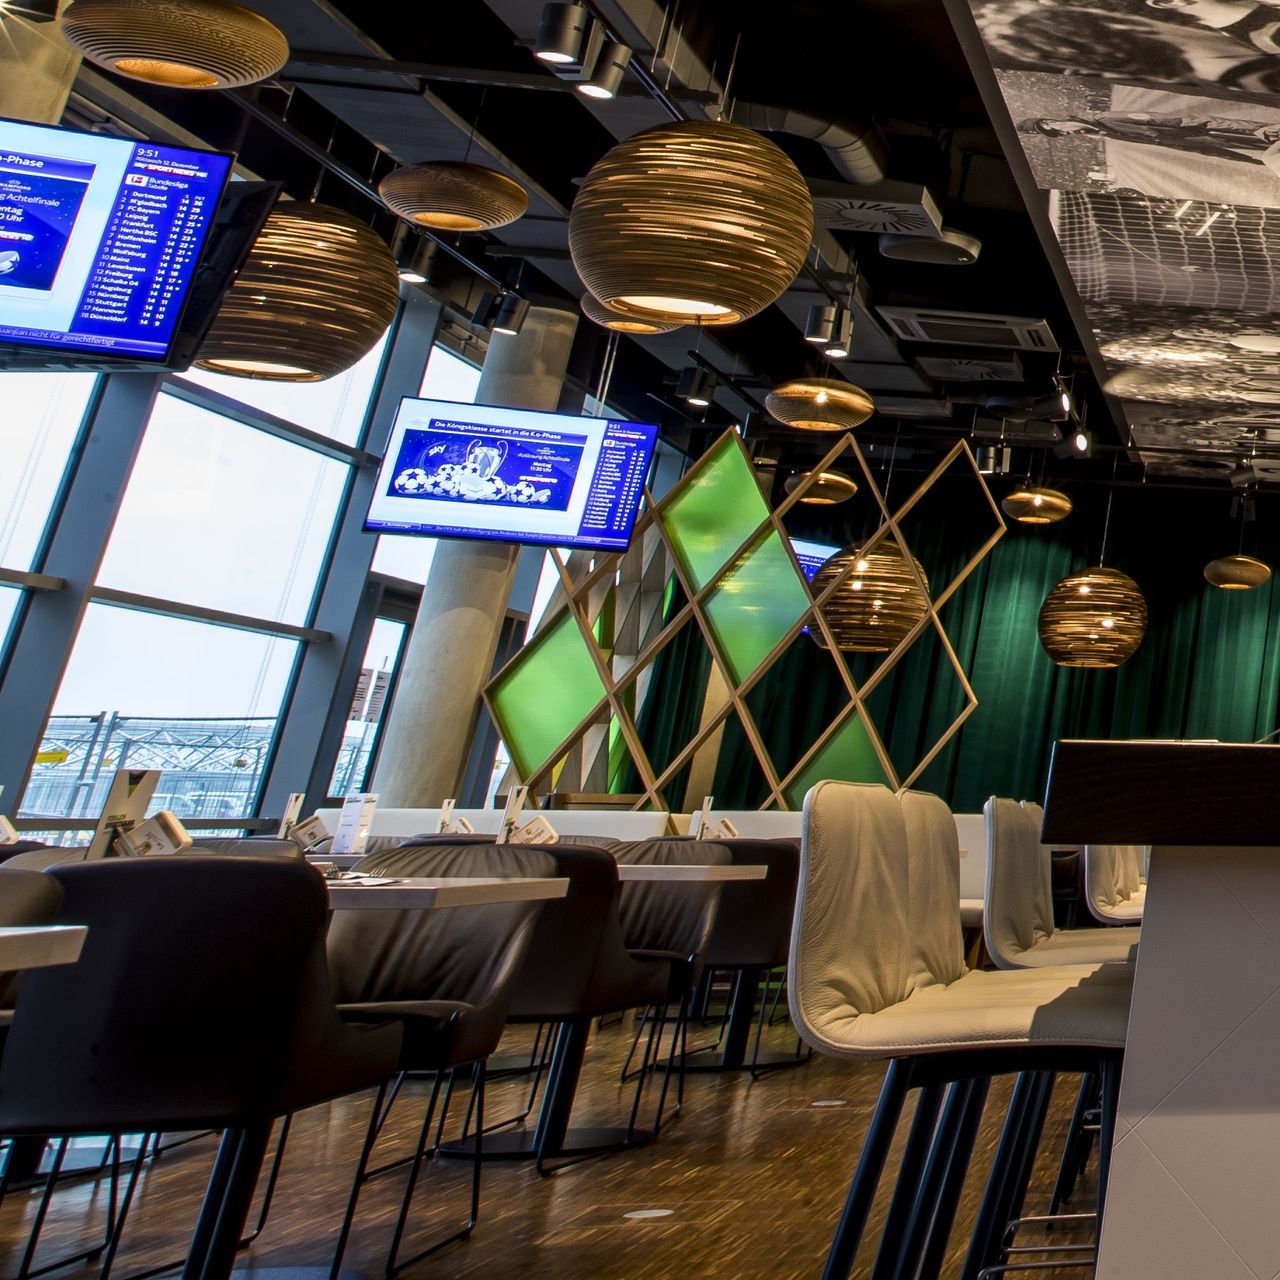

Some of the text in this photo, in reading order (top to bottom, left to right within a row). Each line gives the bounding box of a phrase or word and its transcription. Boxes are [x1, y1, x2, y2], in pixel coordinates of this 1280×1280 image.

[138, 148, 158, 158] 9:51
[149, 177, 188, 189] Bundesliga
[6, 193, 60, 207] Achtelfinale
[132, 192, 167, 201] Dortmund
[137, 207, 160, 216] Bayern
[6, 214, 24, 223] Uhr
[125, 213, 148, 222] Leipzig
[122, 220, 154, 229] Frankfurt
[120, 227, 143, 236] Hertha
[118, 234, 157, 244] Hoffenheim
[115, 241, 142, 250] Bremen
[112, 248, 147, 258] Wolfsburg
[105, 270, 134, 279] Freiburg
[100, 284, 132, 294] Augsburg
[95, 298, 127, 308] Stuttgart
[92, 306, 125, 314] Hannover
[29, 330, 48, 339] nicht
[50, 332, 62, 340] für
[62, 334, 115, 346] gerechtfertigt
[446, 422, 488, 432] Königsklasse
[428, 444, 446, 457] sky
